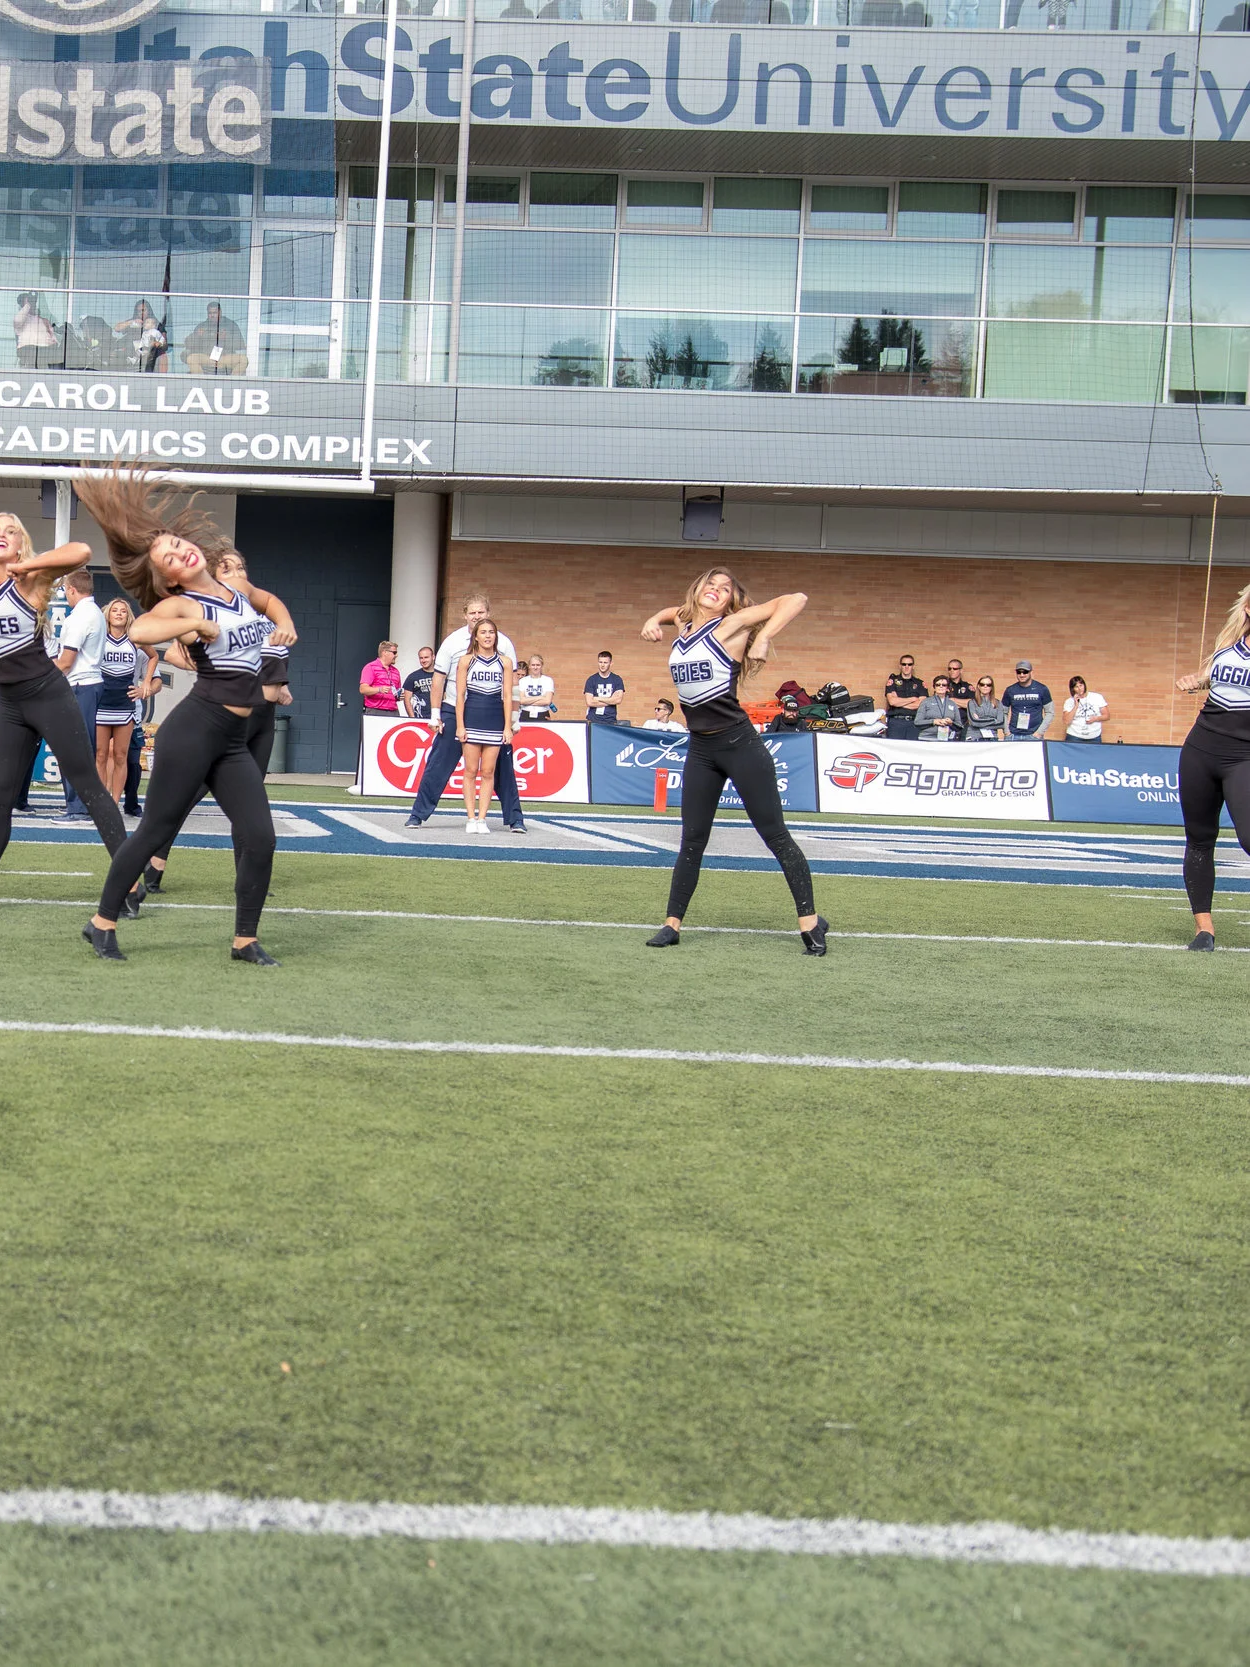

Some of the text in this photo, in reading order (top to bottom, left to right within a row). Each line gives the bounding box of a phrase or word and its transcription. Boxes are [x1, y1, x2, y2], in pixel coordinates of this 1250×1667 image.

[155, 386, 271, 416] LAUB
[670, 661, 712, 683] GGIES
[884, 763, 1038, 796] Sign Pro
[941, 789, 988, 798] GRAPHICS
[1000, 790, 1035, 798] DESIGN
[1137, 791, 1180, 803] ONLIN
